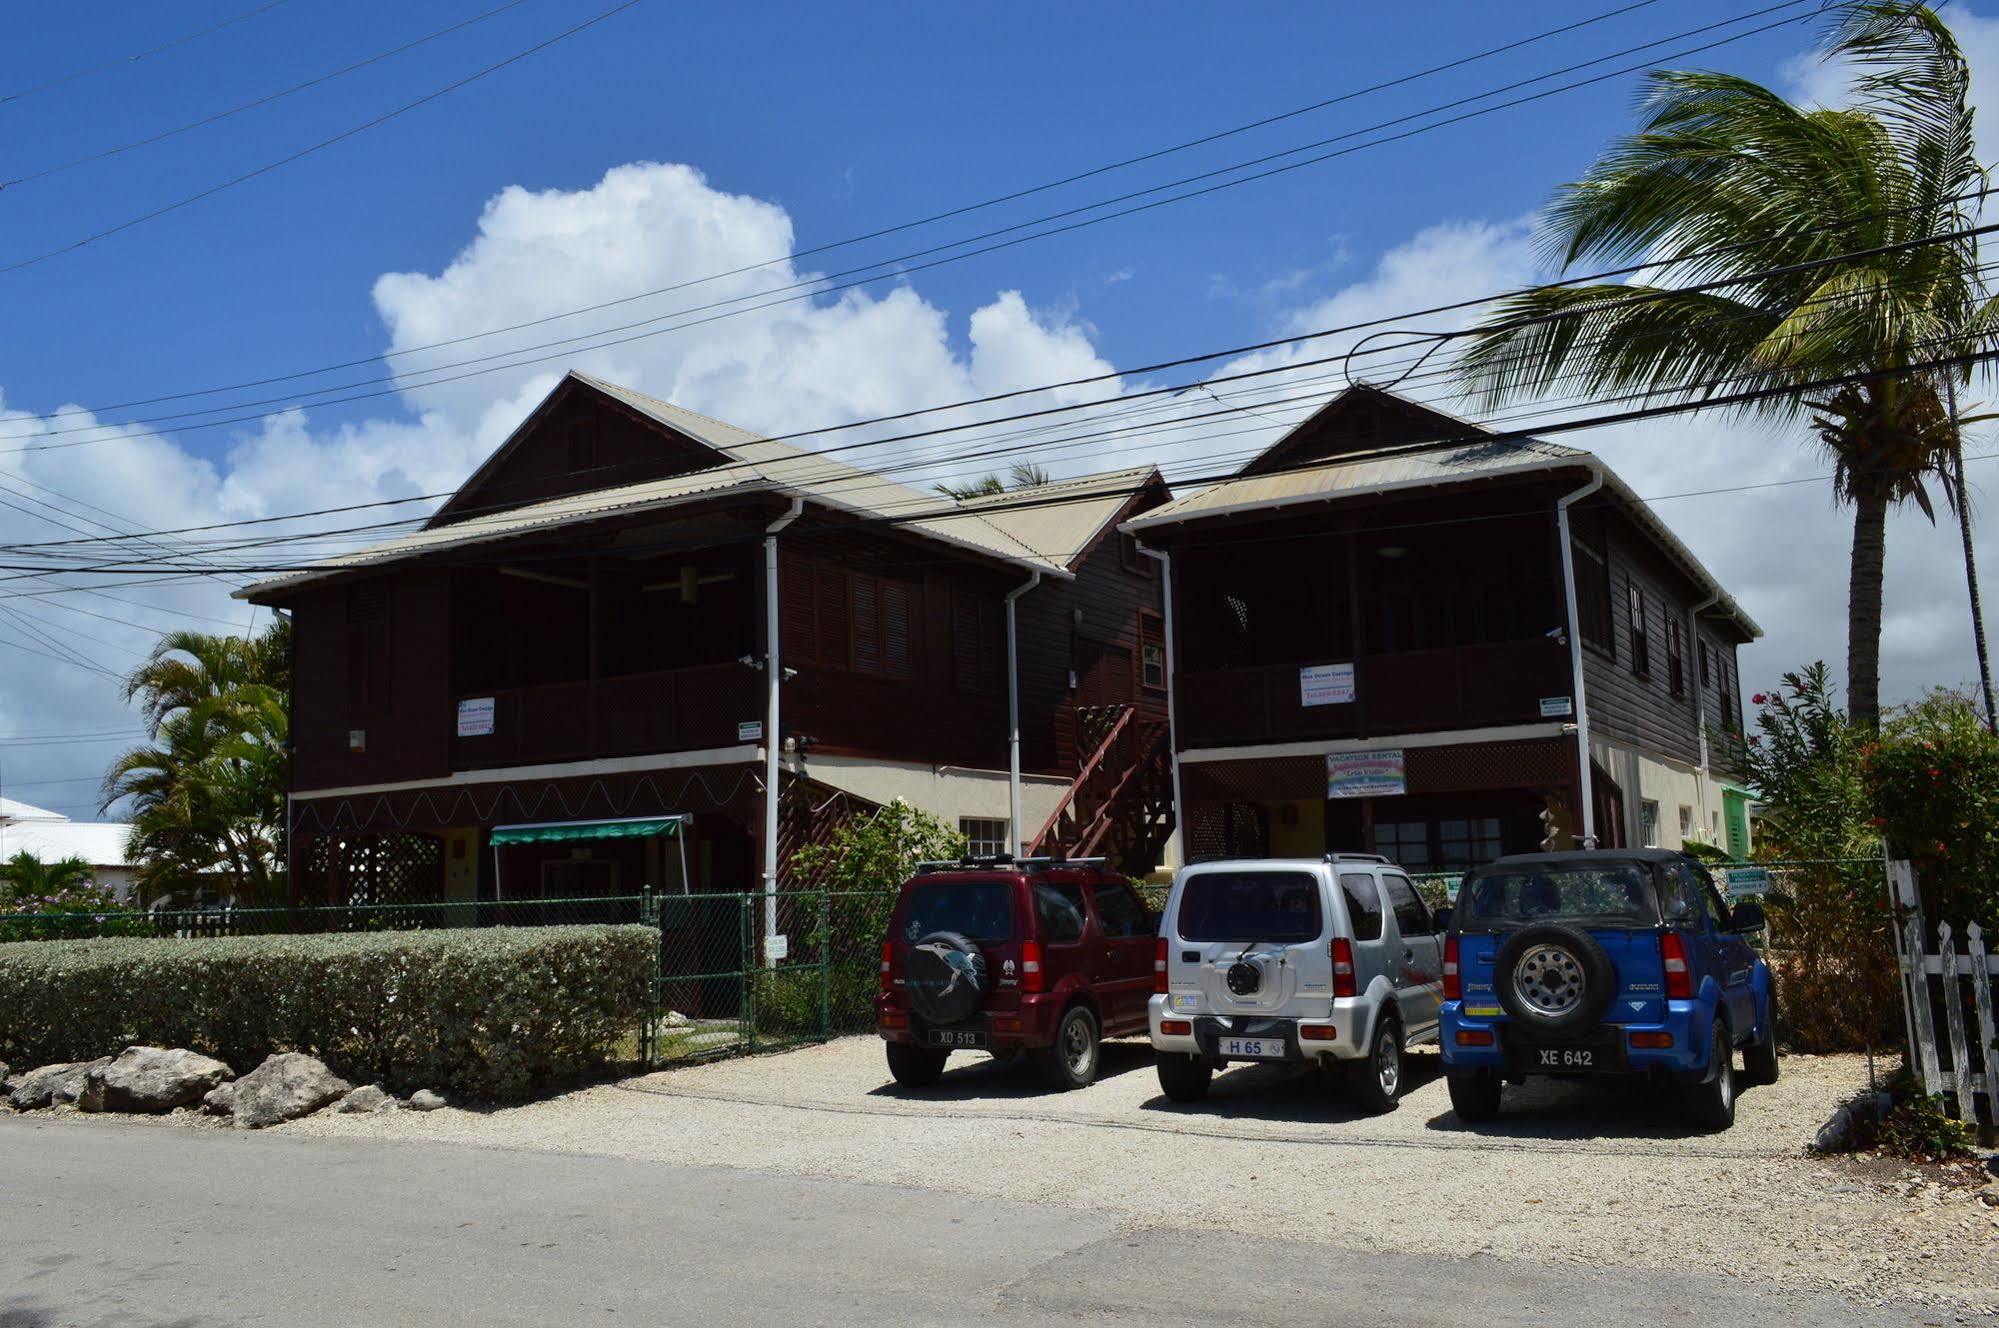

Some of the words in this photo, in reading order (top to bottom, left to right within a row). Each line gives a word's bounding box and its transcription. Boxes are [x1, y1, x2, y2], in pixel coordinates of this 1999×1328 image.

[1329, 753, 1369, 763] VACATION
[1371, 750, 1402, 761] RENTAL
[957, 1032, 976, 1045] 513
[1229, 1040, 1240, 1054] H
[1244, 1040, 1262, 1055] 65
[1540, 1049, 1559, 1065] XE
[1563, 1050, 1593, 1066] 642
